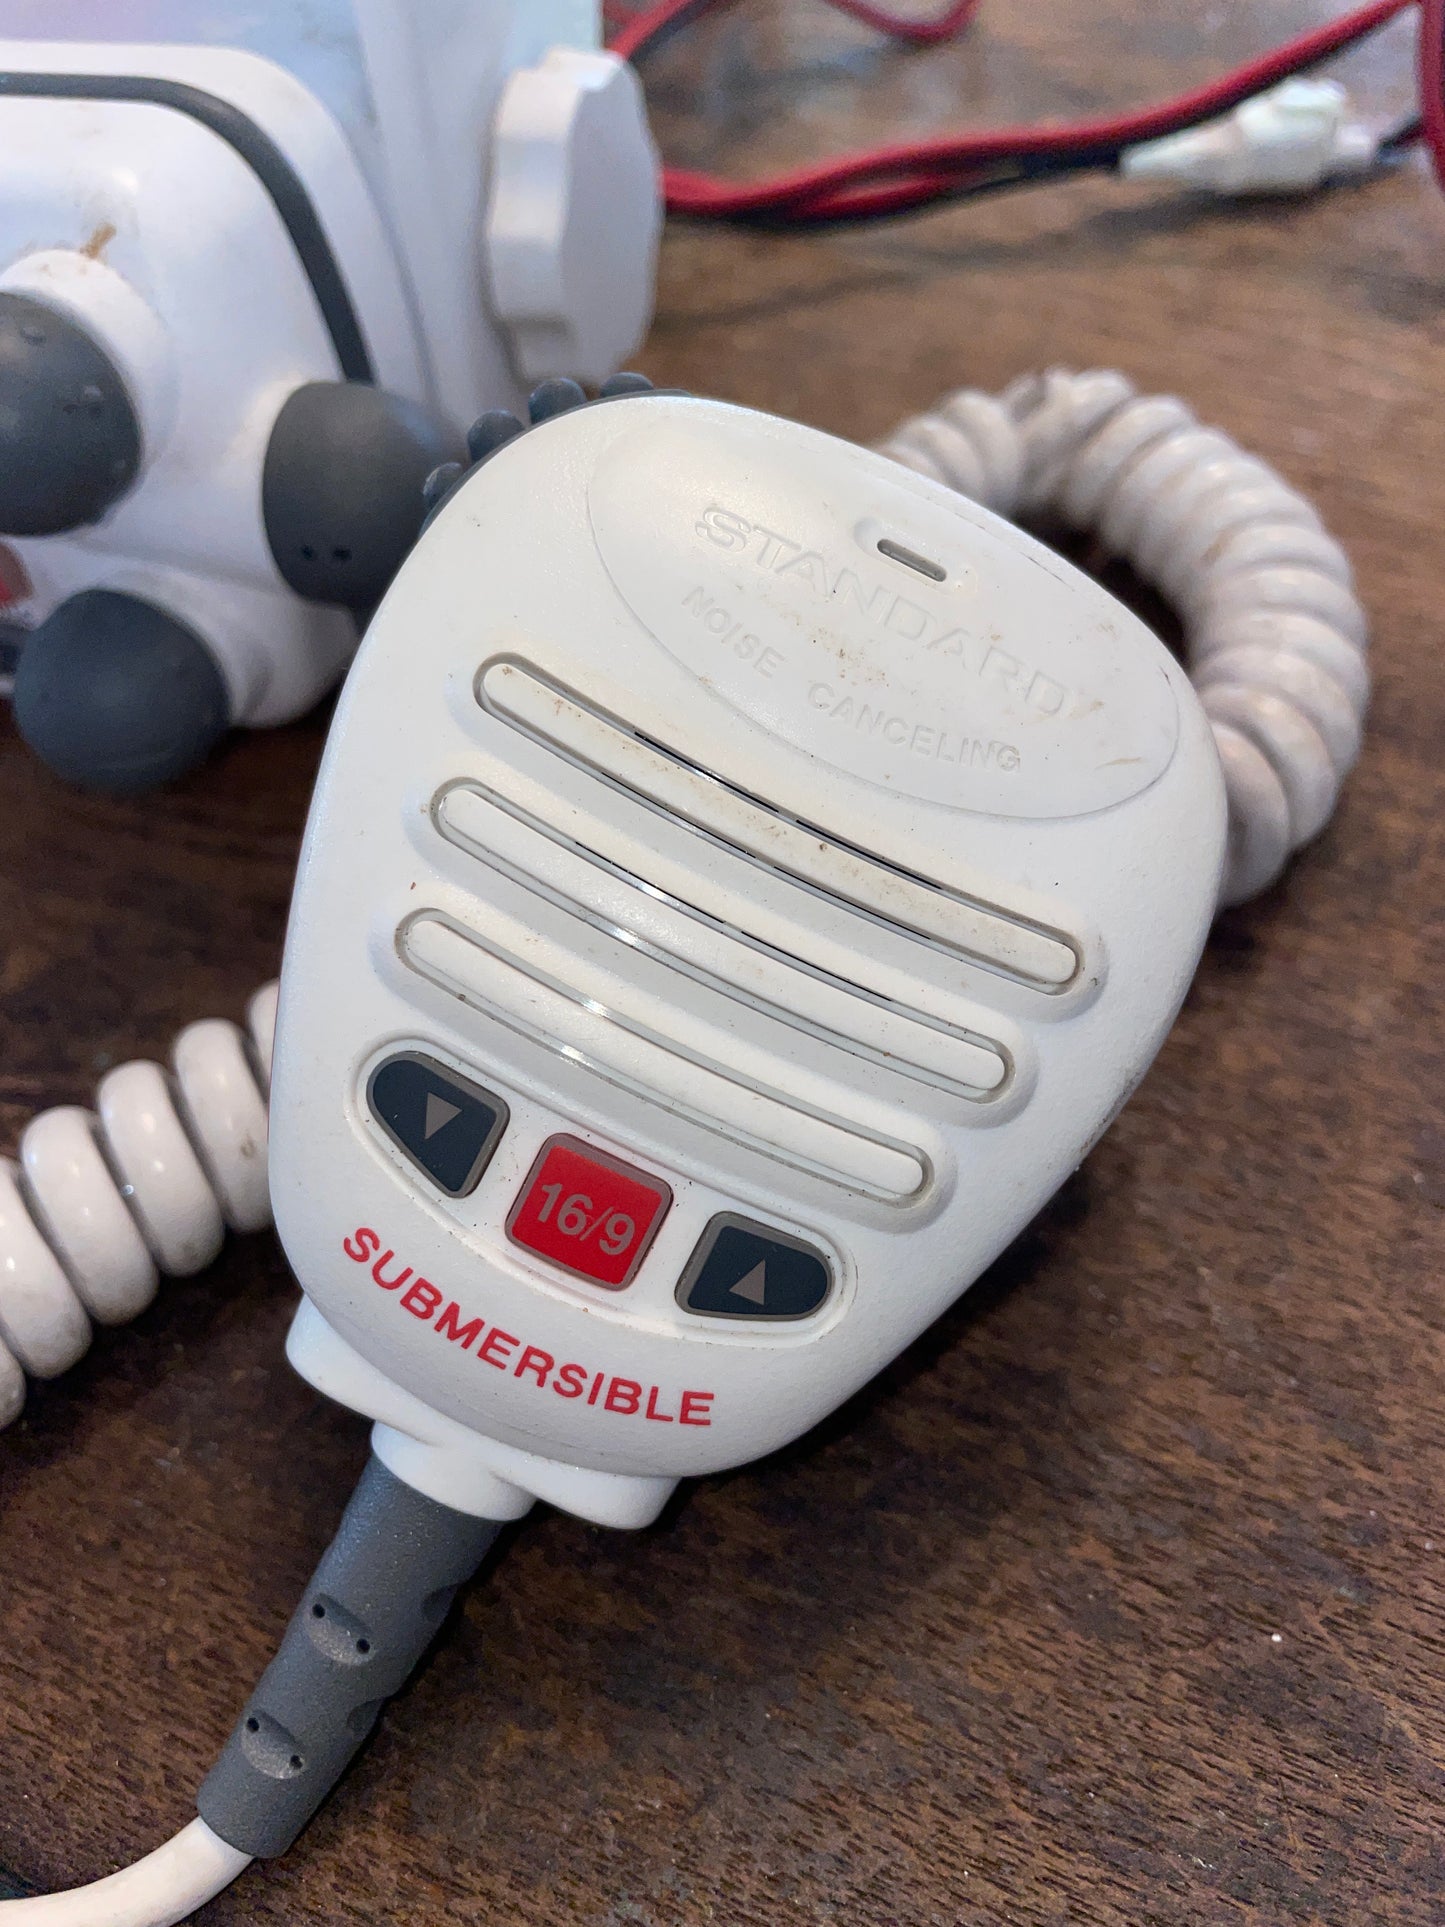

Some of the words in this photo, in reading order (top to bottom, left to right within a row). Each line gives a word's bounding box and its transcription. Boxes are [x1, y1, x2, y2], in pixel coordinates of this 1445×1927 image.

[681, 585, 786, 679] NOISE
[808, 682, 1021, 772] CANCELING
[695, 506, 1072, 715] STANDARD
[539, 1182, 635, 1256] 16/9
[343, 1227, 715, 1426] SUBMERSIBLE
